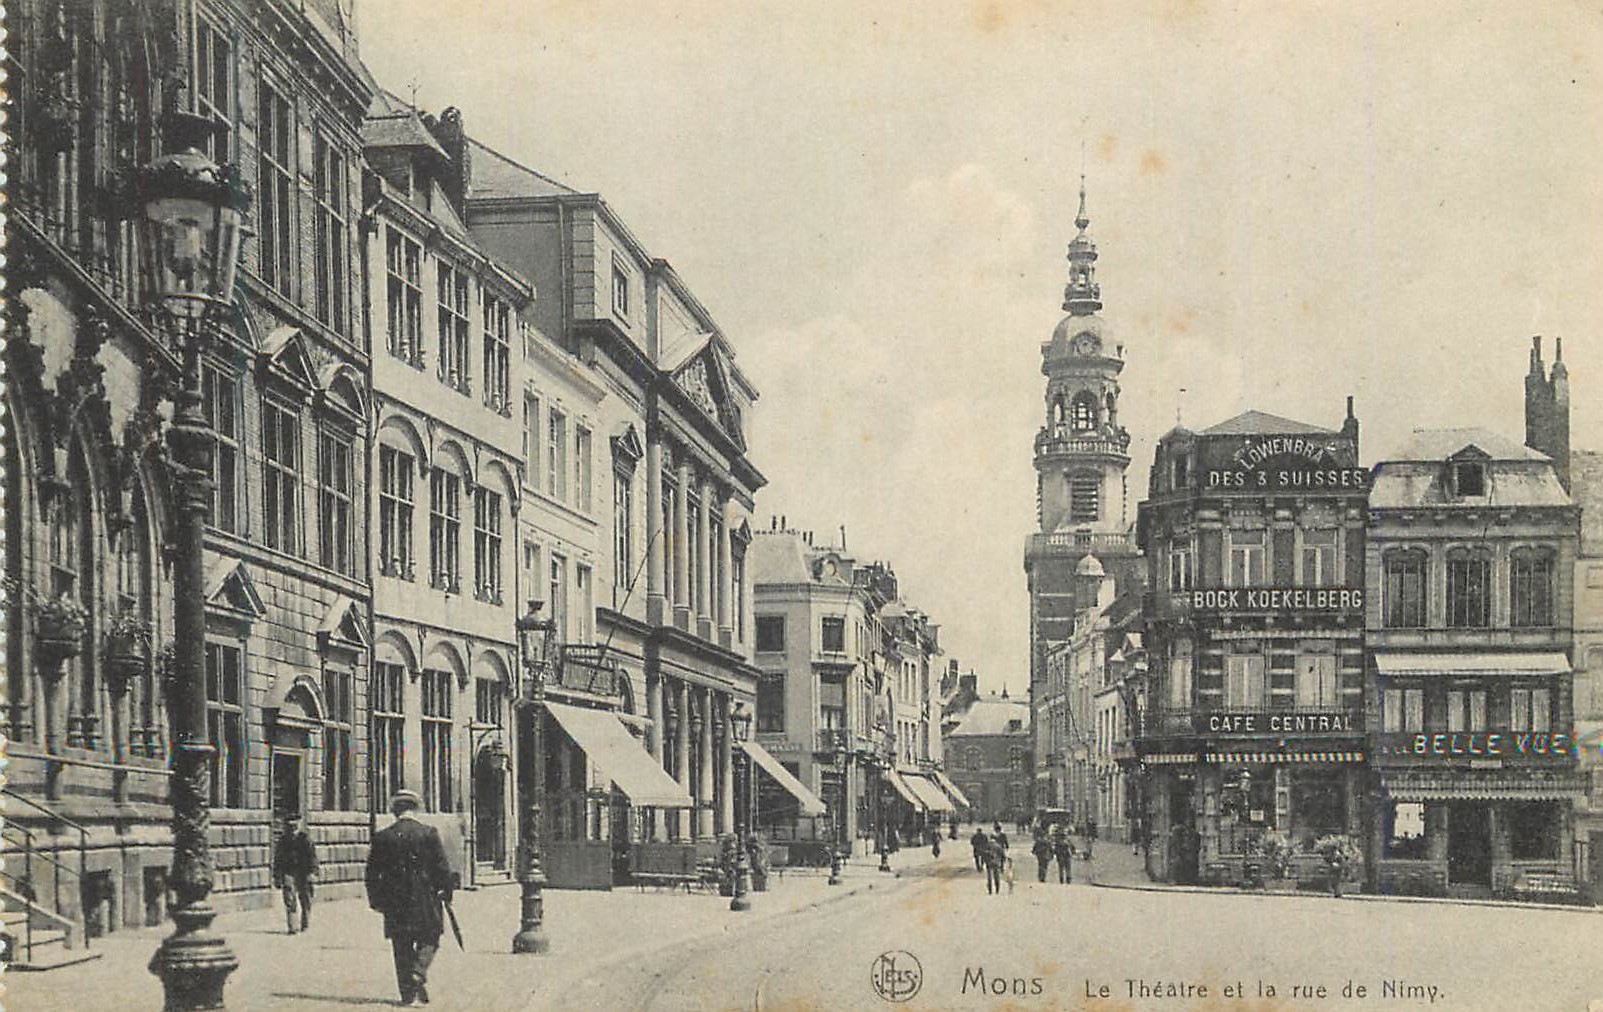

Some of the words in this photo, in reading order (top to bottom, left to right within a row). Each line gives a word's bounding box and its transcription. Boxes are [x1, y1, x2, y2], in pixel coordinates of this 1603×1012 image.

[1210, 471, 1244, 486] DES
[1258, 472, 1267, 485] 3
[1279, 471, 1362, 486] SUISSES
[1194, 590, 1239, 608] BOCK
[1247, 590, 1362, 608] KOEKELBERG
[1210, 716, 1255, 731] CAFE
[1271, 716, 1352, 731] CENTRAL
[1414, 734, 1501, 754] BELLE
[1517, 734, 1568, 754] VUE
